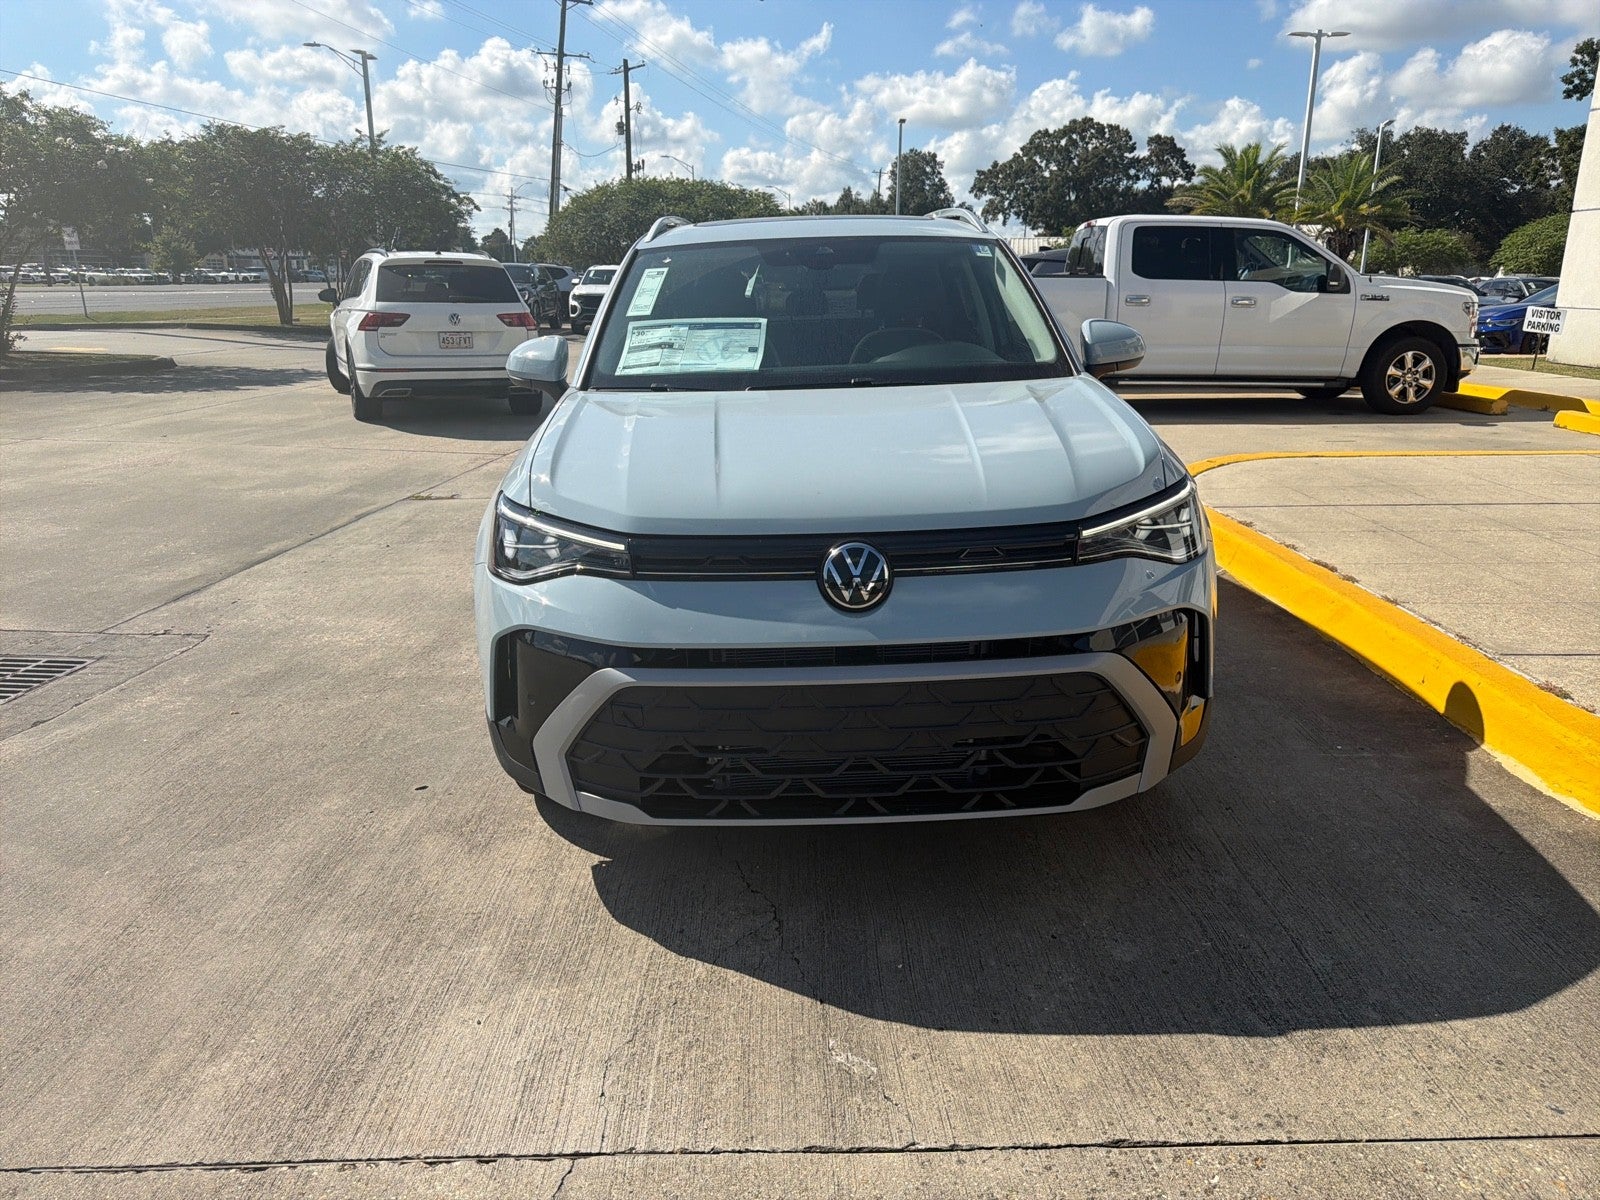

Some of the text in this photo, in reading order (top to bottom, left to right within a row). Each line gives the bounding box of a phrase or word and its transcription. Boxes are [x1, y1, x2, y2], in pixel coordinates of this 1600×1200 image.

[1531, 309, 1562, 320] VISITOR
[1526, 320, 1560, 332] PARKING
[824, 543, 888, 606] VW
